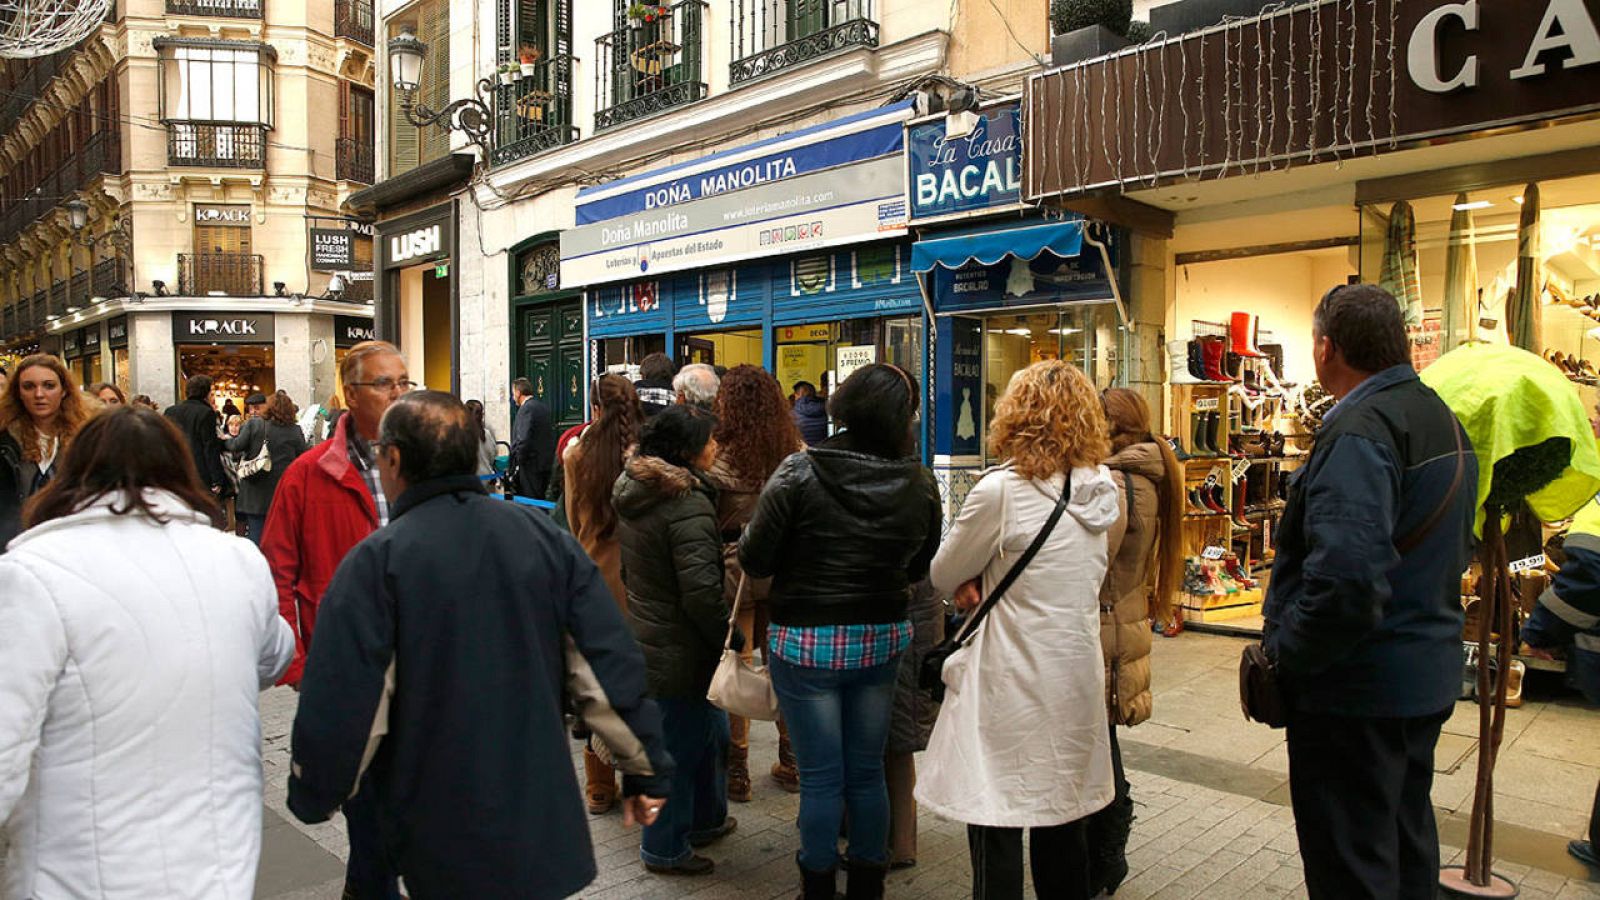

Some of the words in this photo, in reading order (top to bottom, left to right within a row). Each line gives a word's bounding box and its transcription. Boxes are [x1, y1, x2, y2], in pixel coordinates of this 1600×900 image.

[1407, 0, 1600, 92] CA
[928, 136, 957, 166] La
[964, 127, 1016, 159] Casa
[645, 182, 692, 210] DOÑA
[701, 157, 796, 196] MANOLITA
[917, 156, 1020, 206] BACAL
[196, 208, 250, 220] KRACK
[602, 225, 631, 245] Doña
[634, 212, 688, 237] Manolita
[315, 235, 349, 244] LUSH
[315, 244, 349, 252] FRESH
[391, 225, 440, 261] LUSH
[652, 246, 684, 262] Apuestas
[685, 244, 697, 255] del
[697, 238, 724, 252] Estado
[190, 319, 256, 334] KRACK
